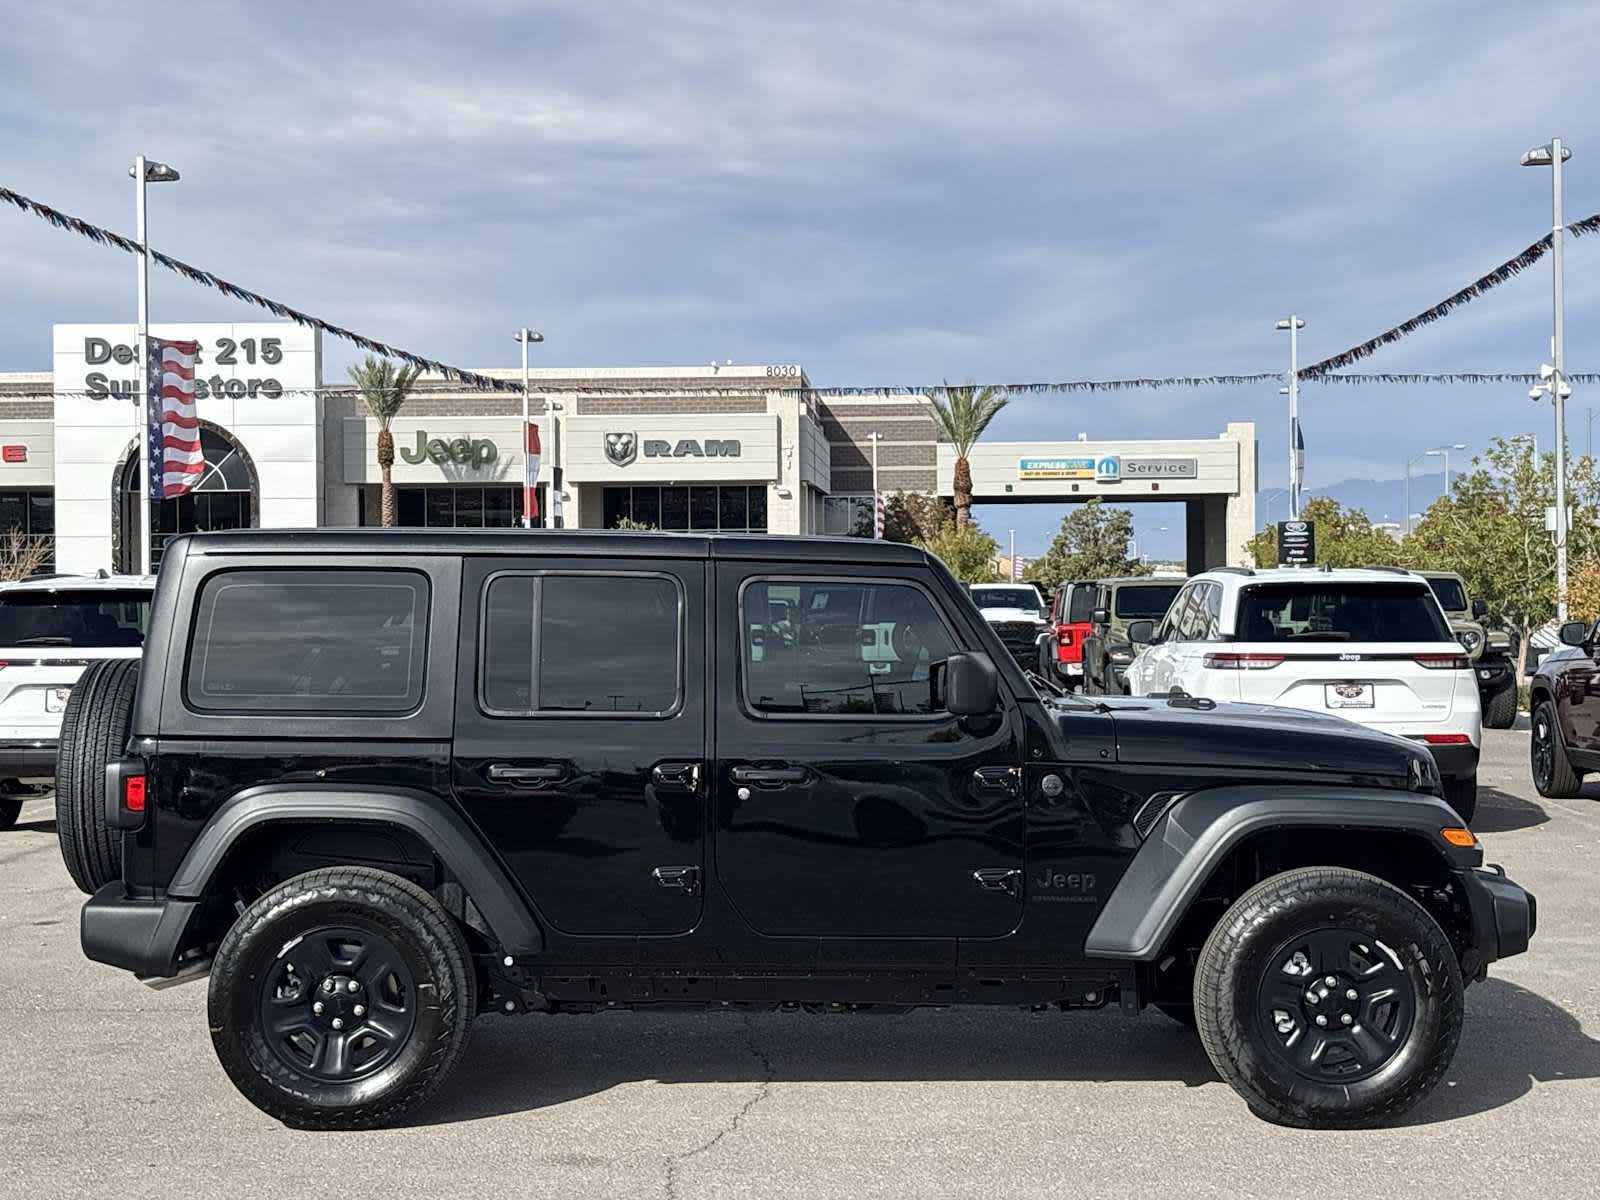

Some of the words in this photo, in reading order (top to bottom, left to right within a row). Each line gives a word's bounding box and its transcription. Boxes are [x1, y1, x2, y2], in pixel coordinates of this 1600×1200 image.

[215, 337, 284, 365] 215
[766, 366, 796, 377] 8030
[85, 372, 284, 407] Sustore
[400, 430, 498, 470] Jeep
[643, 439, 741, 458] RAM
[1127, 462, 1188, 473] Service
[1338, 652, 1361, 662] Jeep
[1036, 868, 1096, 893] Jeep
